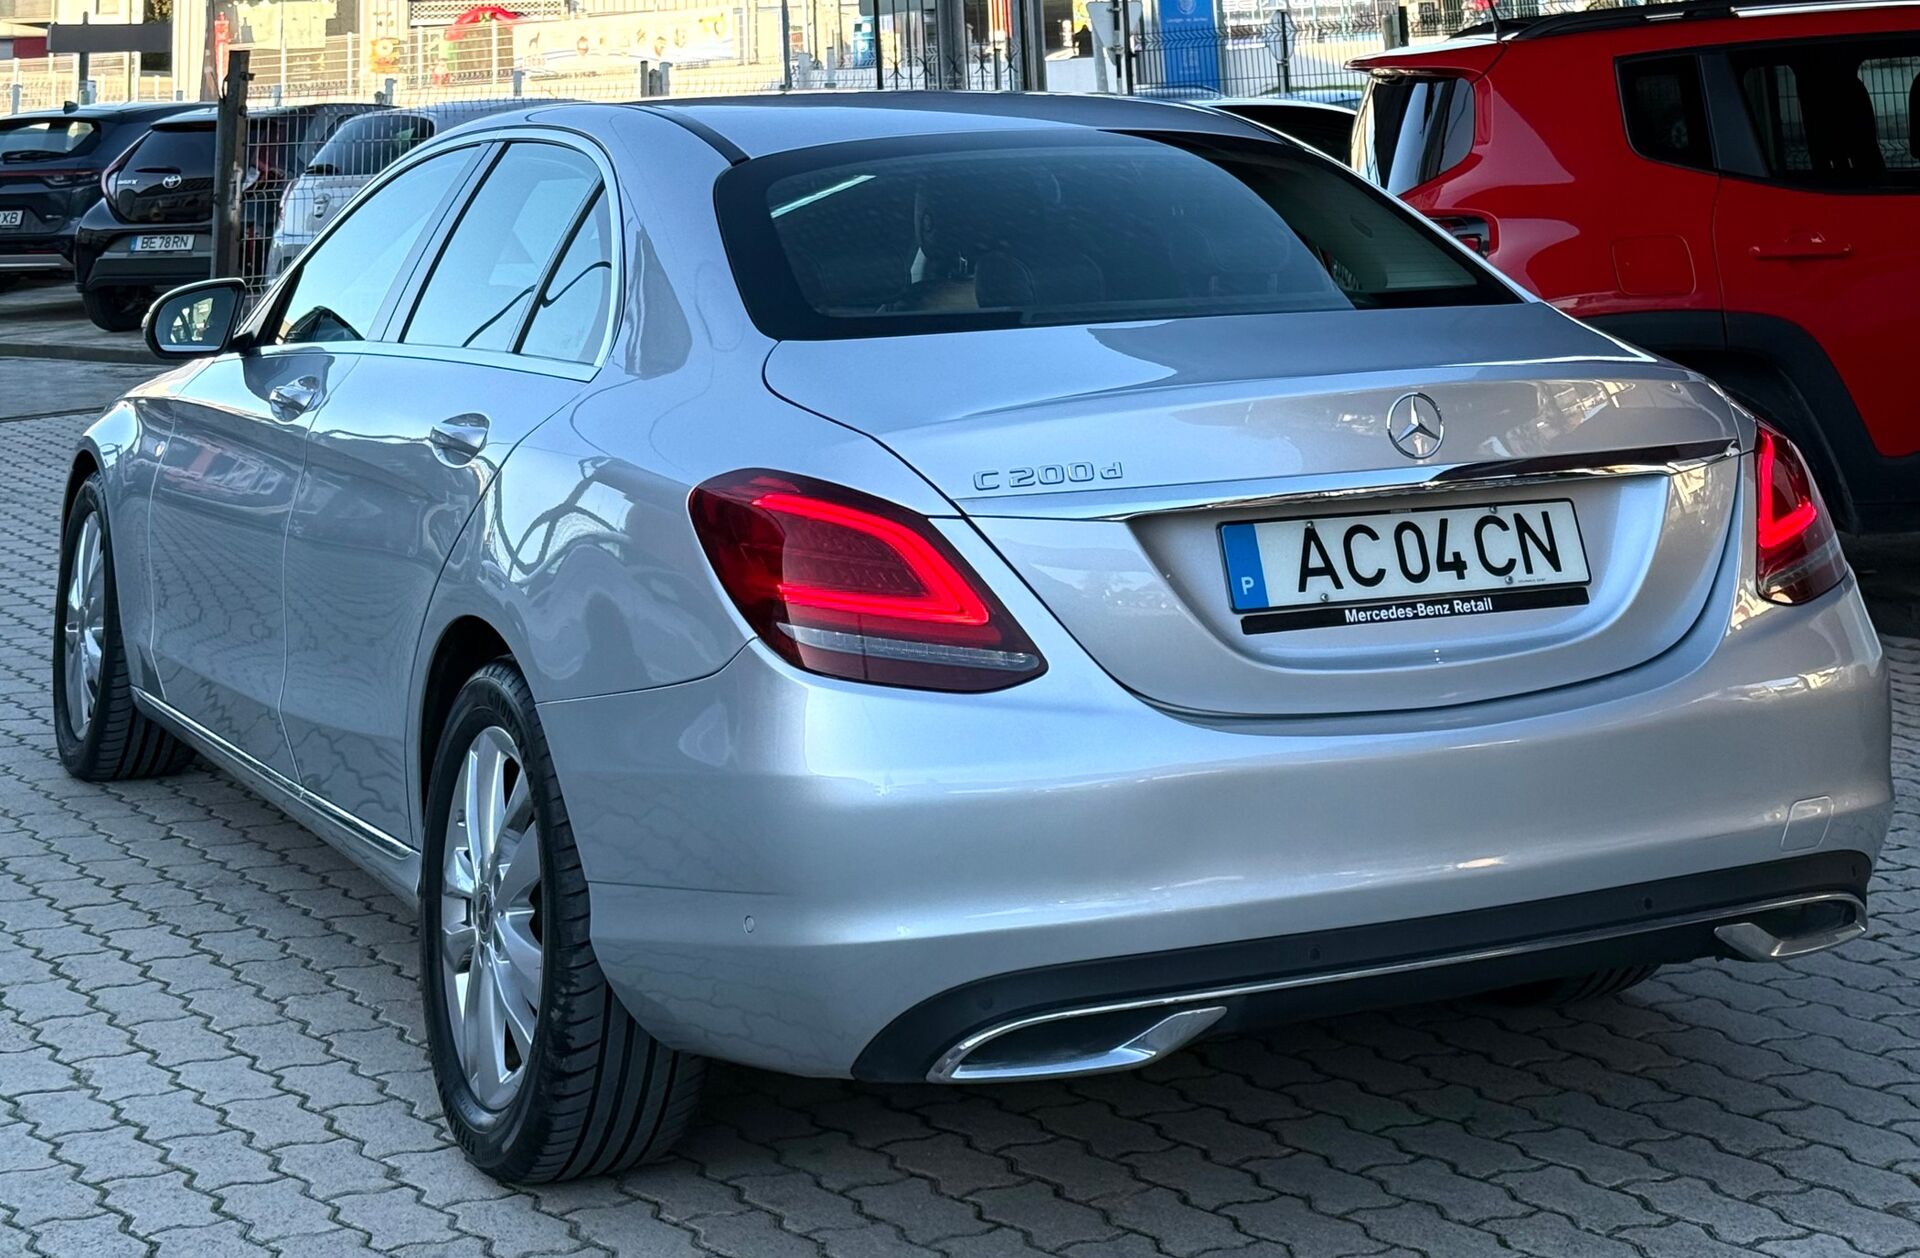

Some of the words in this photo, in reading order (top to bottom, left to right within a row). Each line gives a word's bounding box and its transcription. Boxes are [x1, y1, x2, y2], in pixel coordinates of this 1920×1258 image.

[0, 211, 19, 224] XB
[973, 470, 1000, 491] C
[1240, 576, 1255, 596] P
[1344, 602, 1451, 623] Mercedes-Benz
[1453, 597, 1493, 614] Retail
